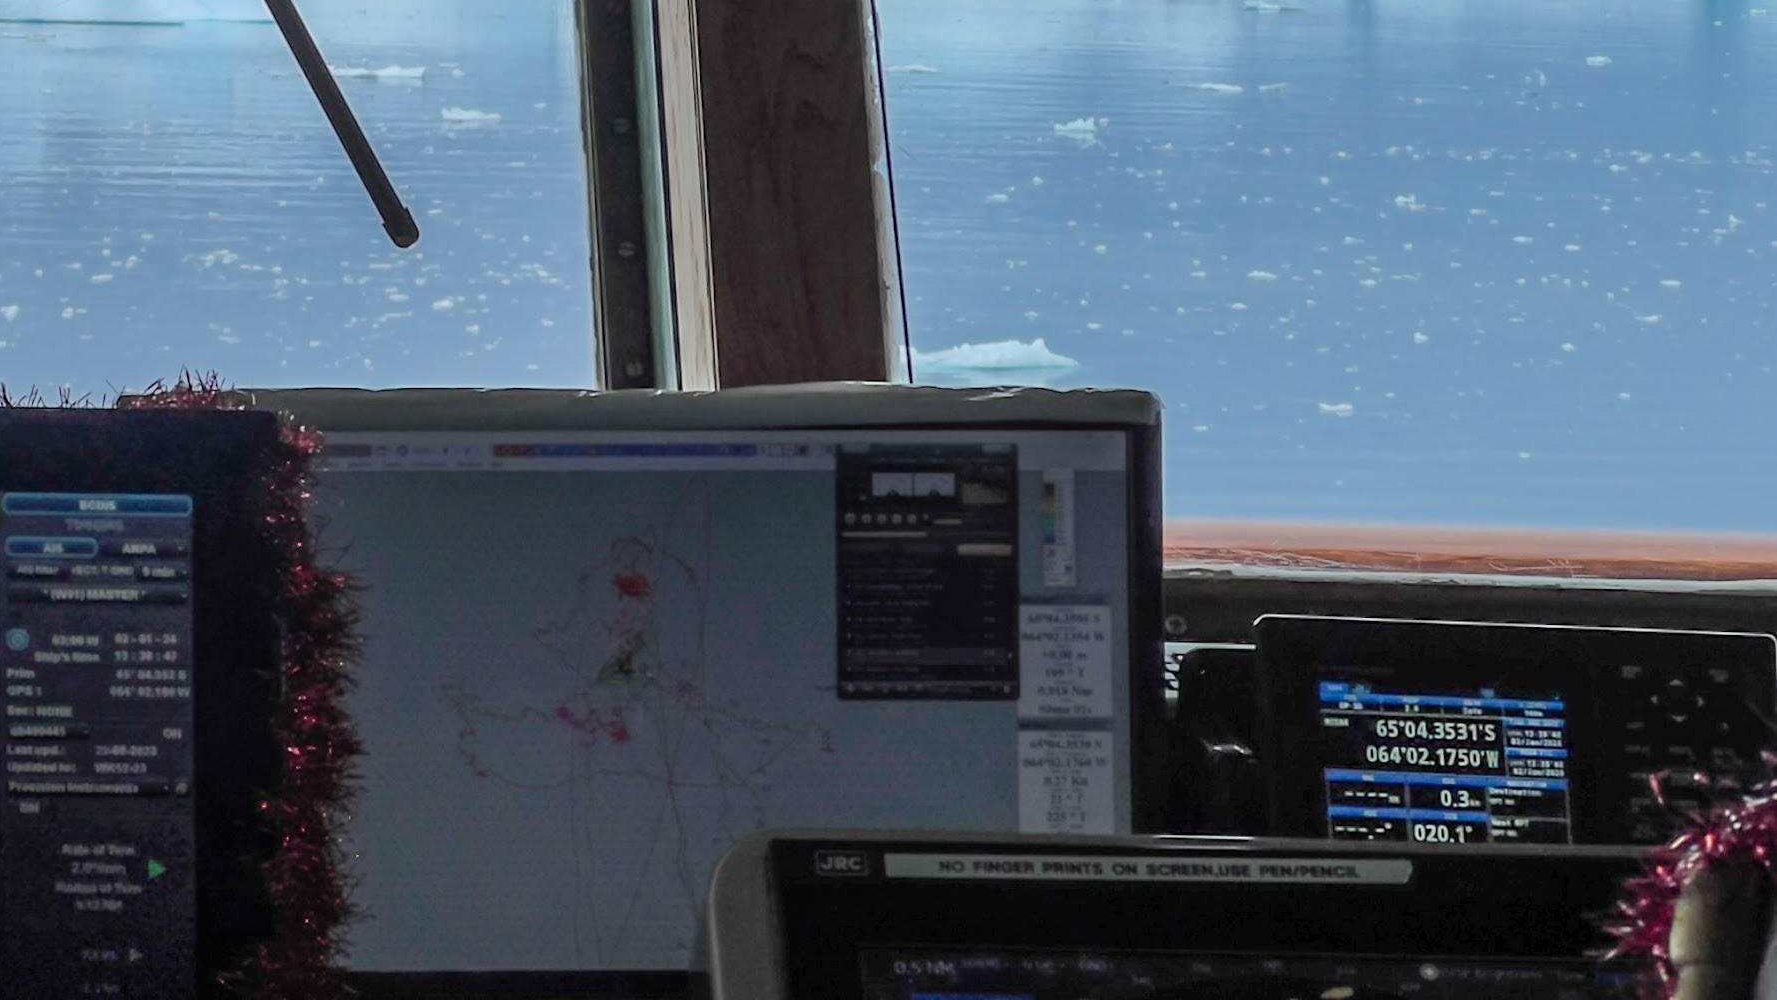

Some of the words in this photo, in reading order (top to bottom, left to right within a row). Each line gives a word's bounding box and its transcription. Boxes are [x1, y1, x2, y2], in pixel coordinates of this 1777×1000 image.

[1439, 789, 1470, 809] 0.3
[820, 855, 863, 871] JRC
[938, 860, 965, 873] NO
[972, 860, 1036, 874] FINGER
[1040, 861, 1104, 875] PRINTS
[1111, 863, 1138, 876] ON
[1259, 865, 1361, 880] PEN/PENCIL
